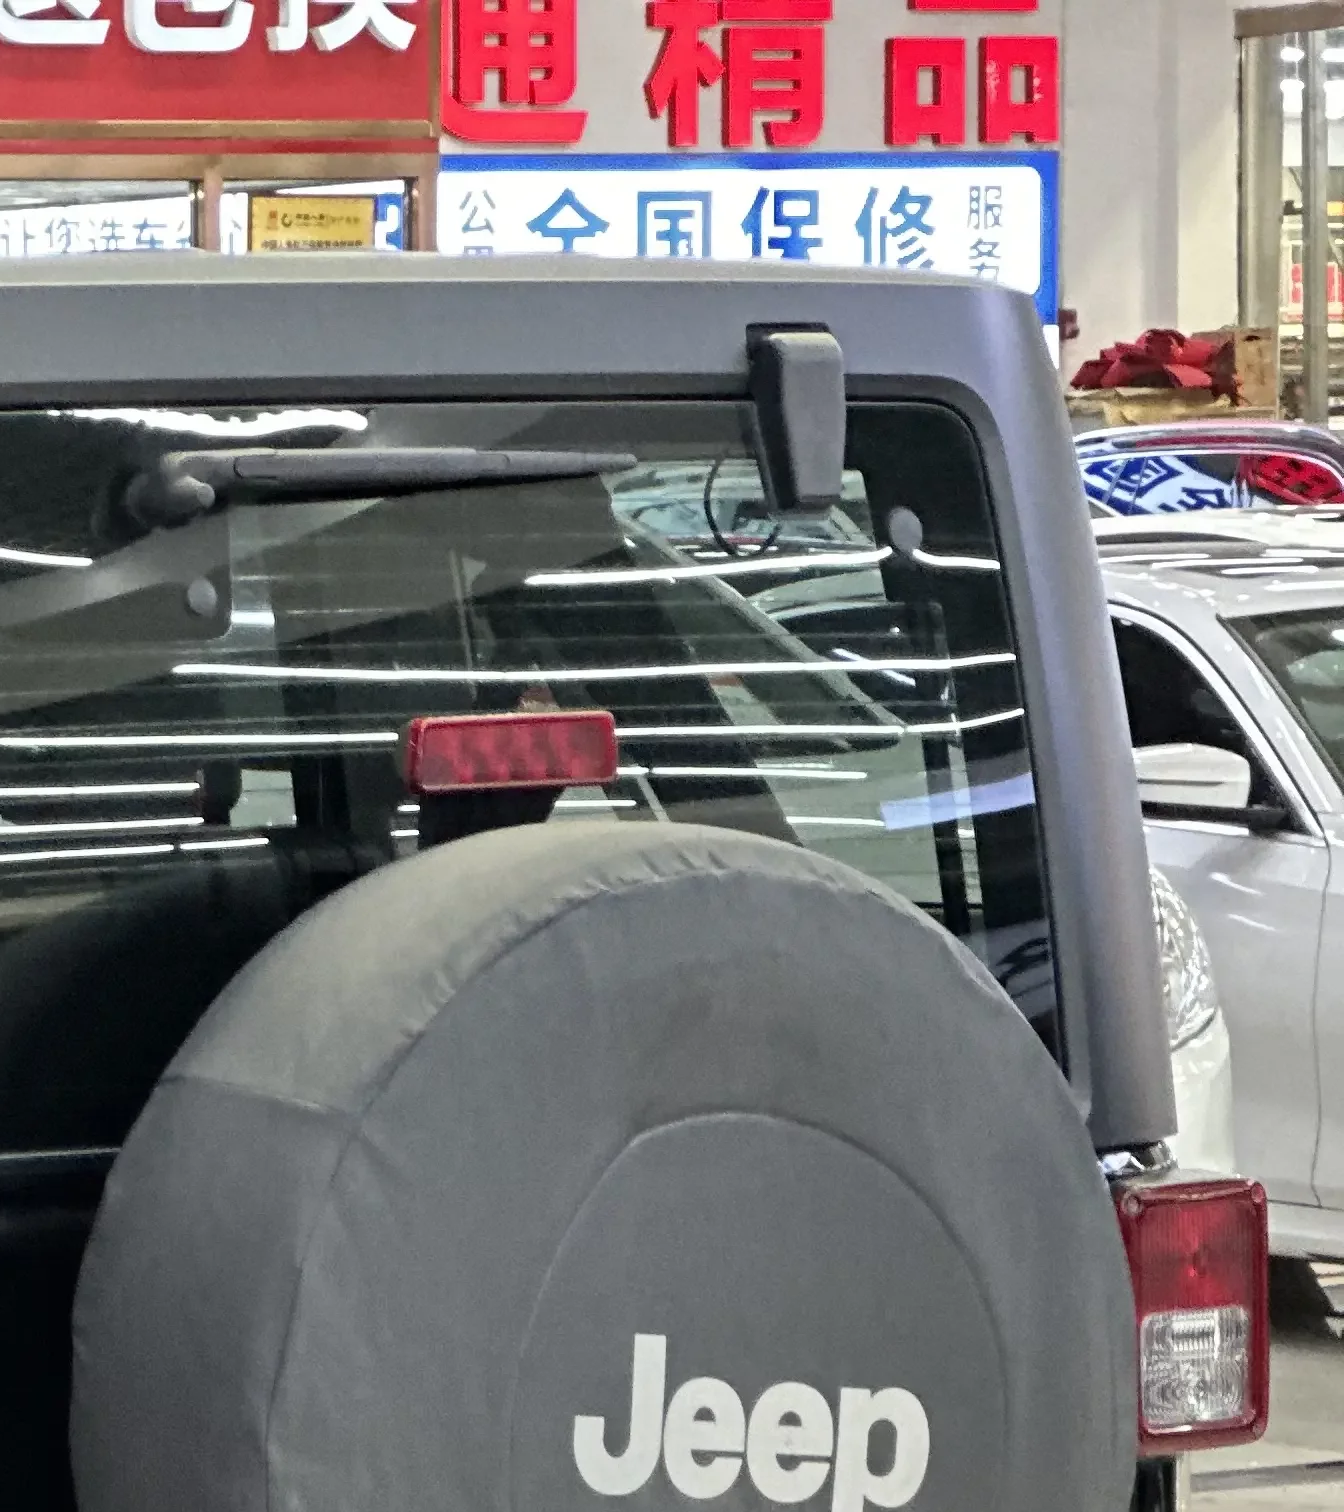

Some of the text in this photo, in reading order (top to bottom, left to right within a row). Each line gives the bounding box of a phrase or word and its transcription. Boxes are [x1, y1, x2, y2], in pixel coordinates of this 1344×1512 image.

[442, 0, 1059, 147] 通精品
[458, 187, 496, 257] 公
[525, 185, 936, 270] 全国保修
[966, 184, 1004, 279] 服务
